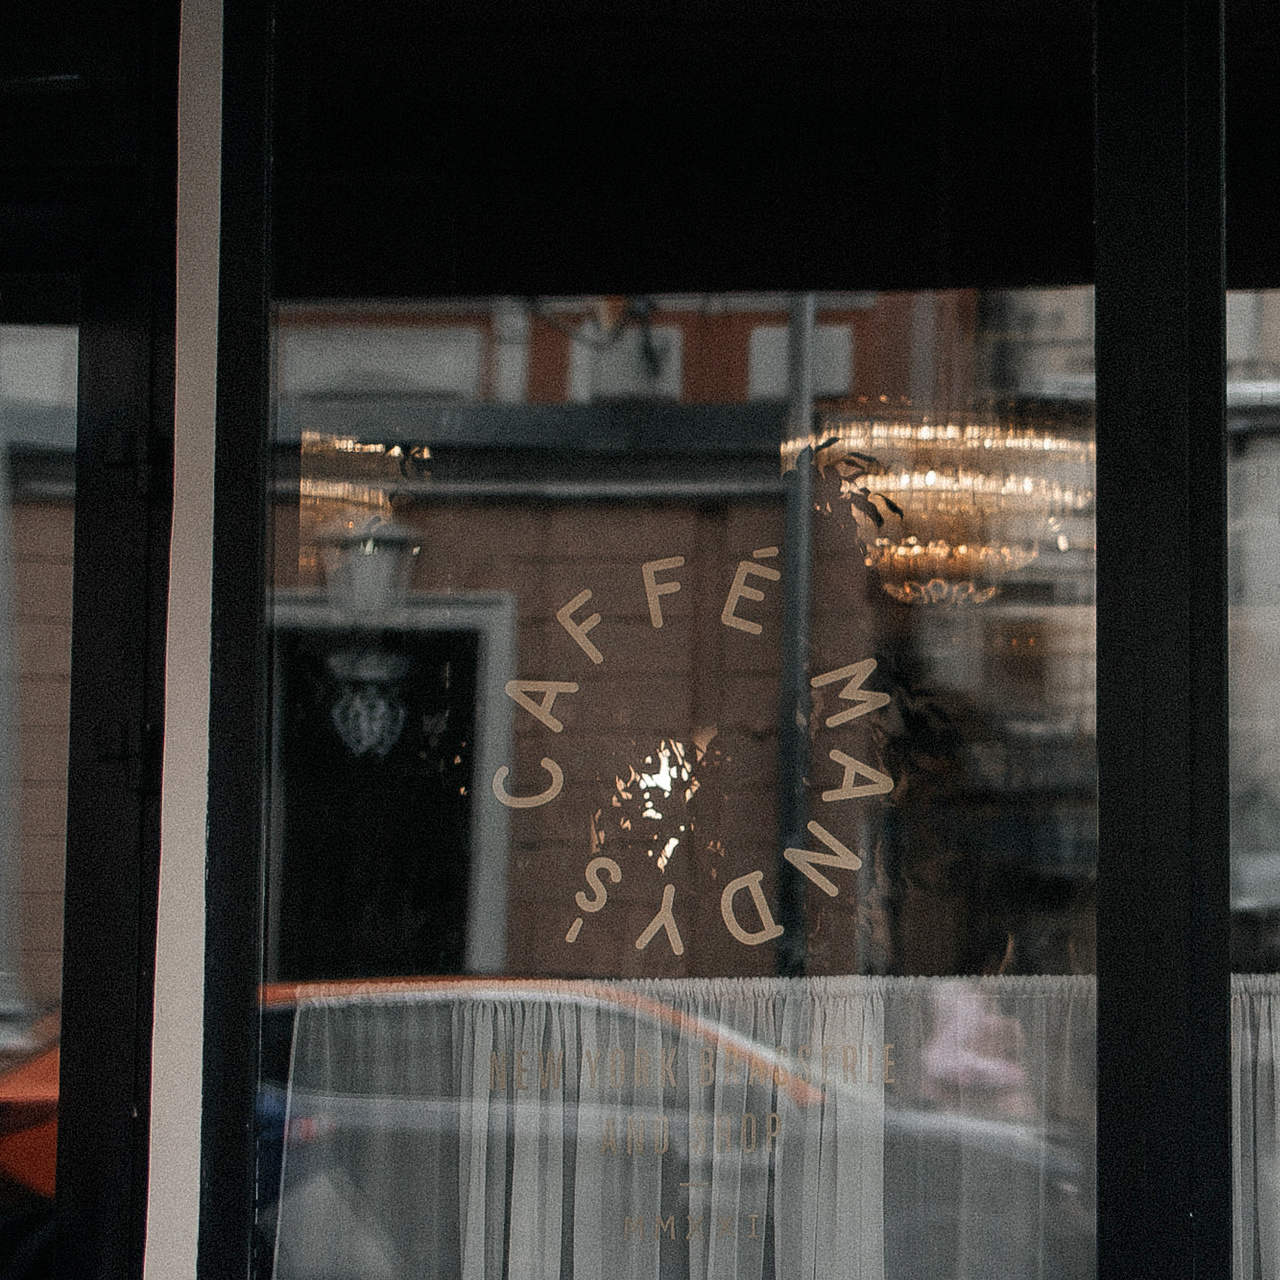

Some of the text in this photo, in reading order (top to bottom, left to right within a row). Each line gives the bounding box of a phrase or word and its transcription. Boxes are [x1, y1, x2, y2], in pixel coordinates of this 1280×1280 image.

[491, 546, 782, 809] CAFFÉ
[488, 1042, 896, 1091] NEW YORK BRASSERIE
[600, 1111, 783, 1157] AND SHOP
[623, 1213, 761, 1242] MMXXI
